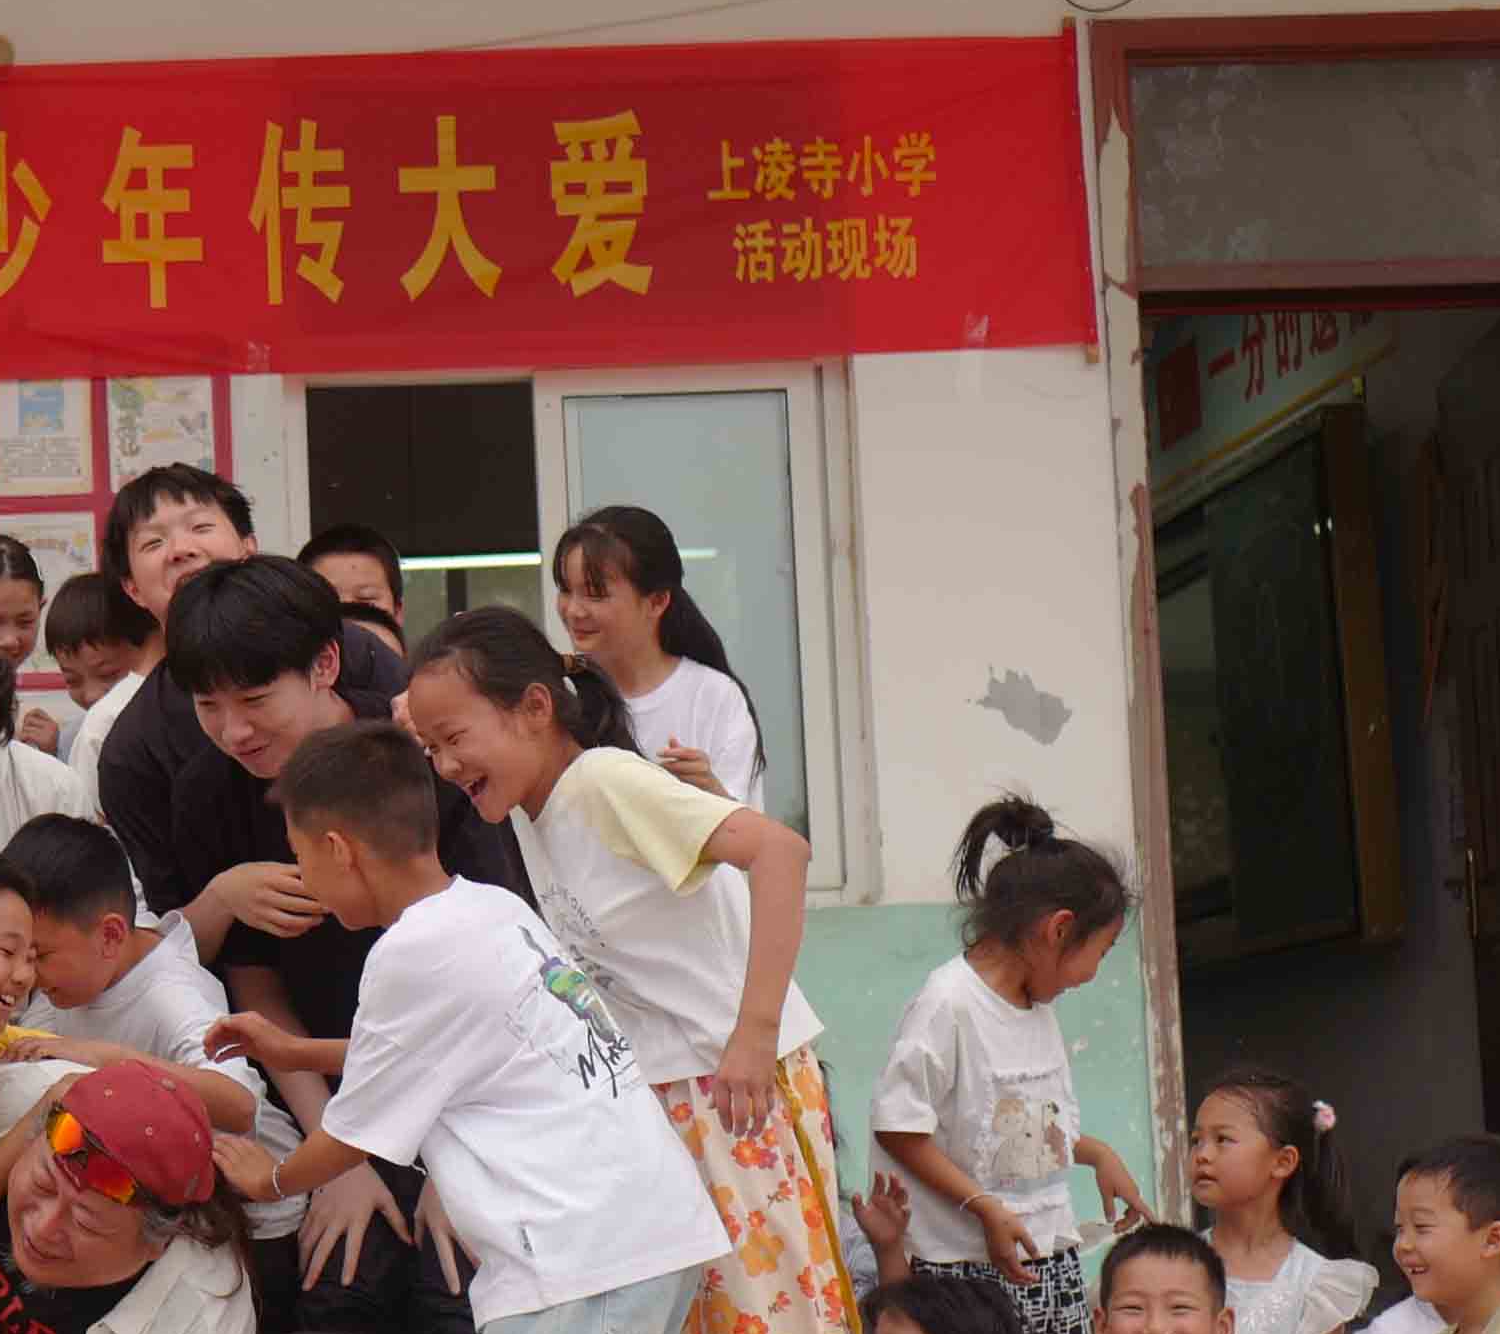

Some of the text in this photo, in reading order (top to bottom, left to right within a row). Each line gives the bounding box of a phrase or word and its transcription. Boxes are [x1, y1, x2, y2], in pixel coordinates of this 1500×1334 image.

[706, 131, 937, 201] 上凌寺小学
[732, 214, 918, 284] 活动现场
